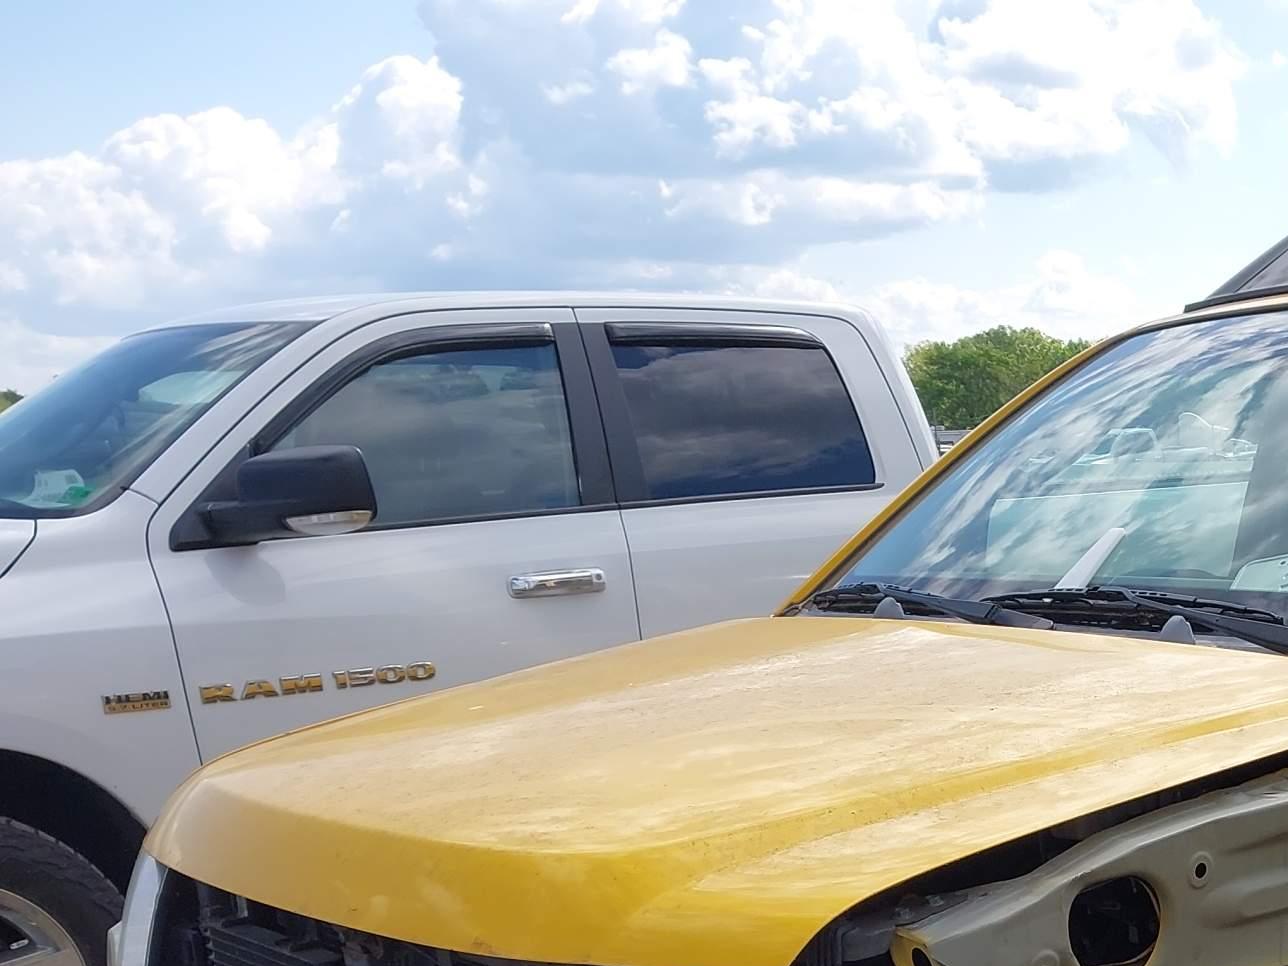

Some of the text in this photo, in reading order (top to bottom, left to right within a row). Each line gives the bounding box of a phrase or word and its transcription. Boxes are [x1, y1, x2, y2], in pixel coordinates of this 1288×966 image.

[199, 660, 436, 704] RAM 1500
[103, 690, 169, 704] HEMI
